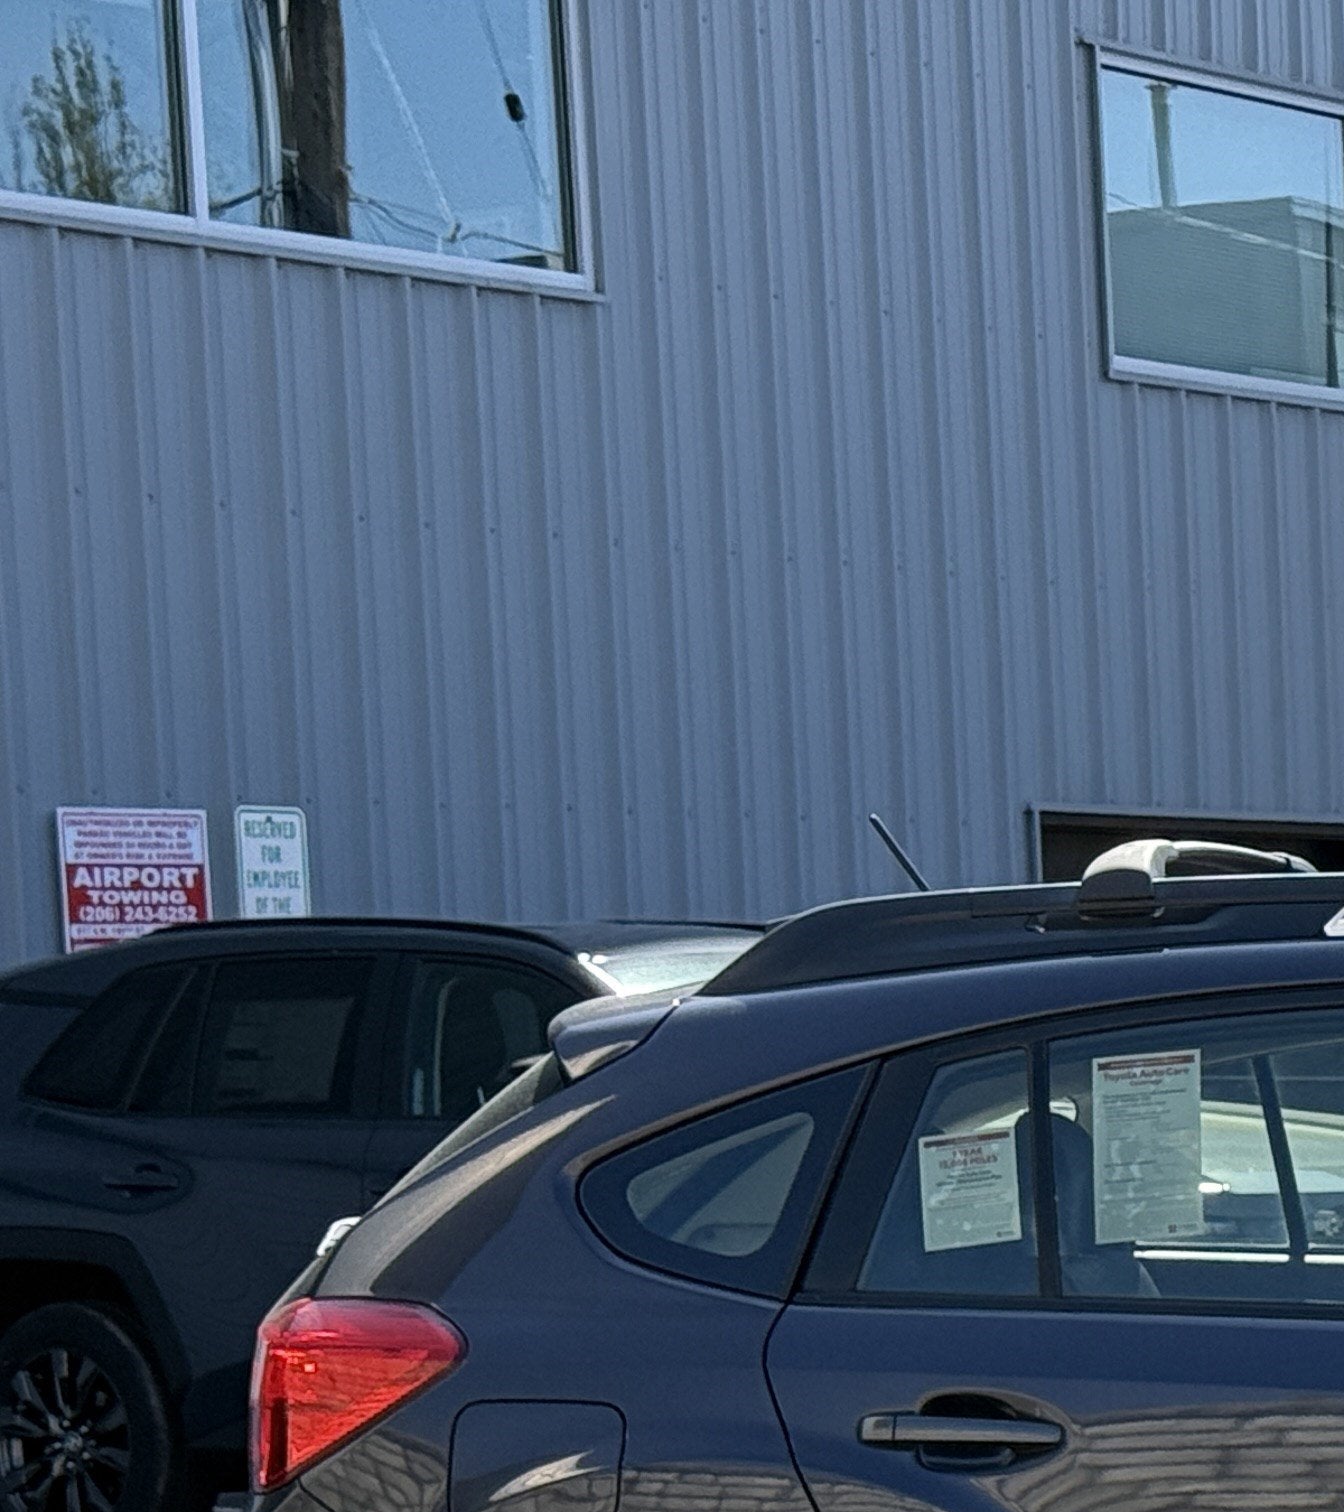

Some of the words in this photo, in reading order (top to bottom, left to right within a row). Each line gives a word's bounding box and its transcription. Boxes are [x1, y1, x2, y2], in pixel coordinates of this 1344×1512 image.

[244, 820, 296, 839] RESERVED
[261, 845, 282, 863] FOR
[73, 866, 199, 888] AIRPORT
[246, 869, 300, 889] EMPLOYEE
[87, 890, 188, 905] TOWING
[256, 896, 268, 914] OF
[272, 896, 292, 914] THE
[79, 905, 121, 922] (206)
[124, 905, 198, 923] 243-6252
